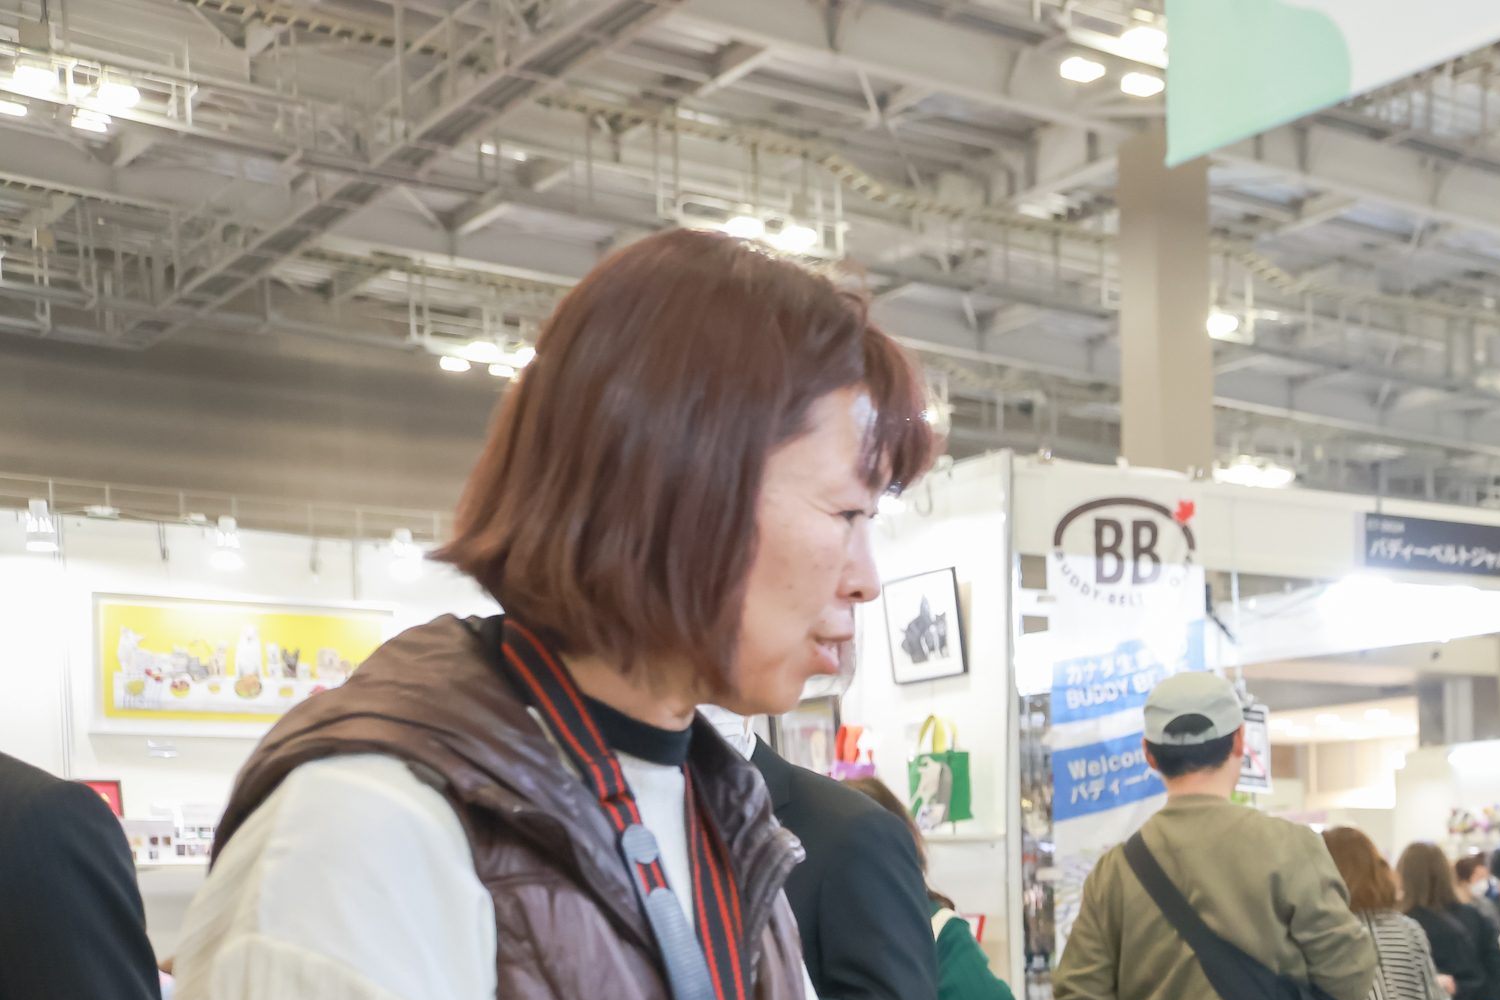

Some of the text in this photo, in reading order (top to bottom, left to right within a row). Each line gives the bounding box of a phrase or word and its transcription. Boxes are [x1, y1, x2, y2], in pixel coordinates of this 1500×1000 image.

[1095, 518, 1161, 584] BB
[1065, 677, 1129, 709] BUDDY
[1067, 749, 1147, 781] Welco
